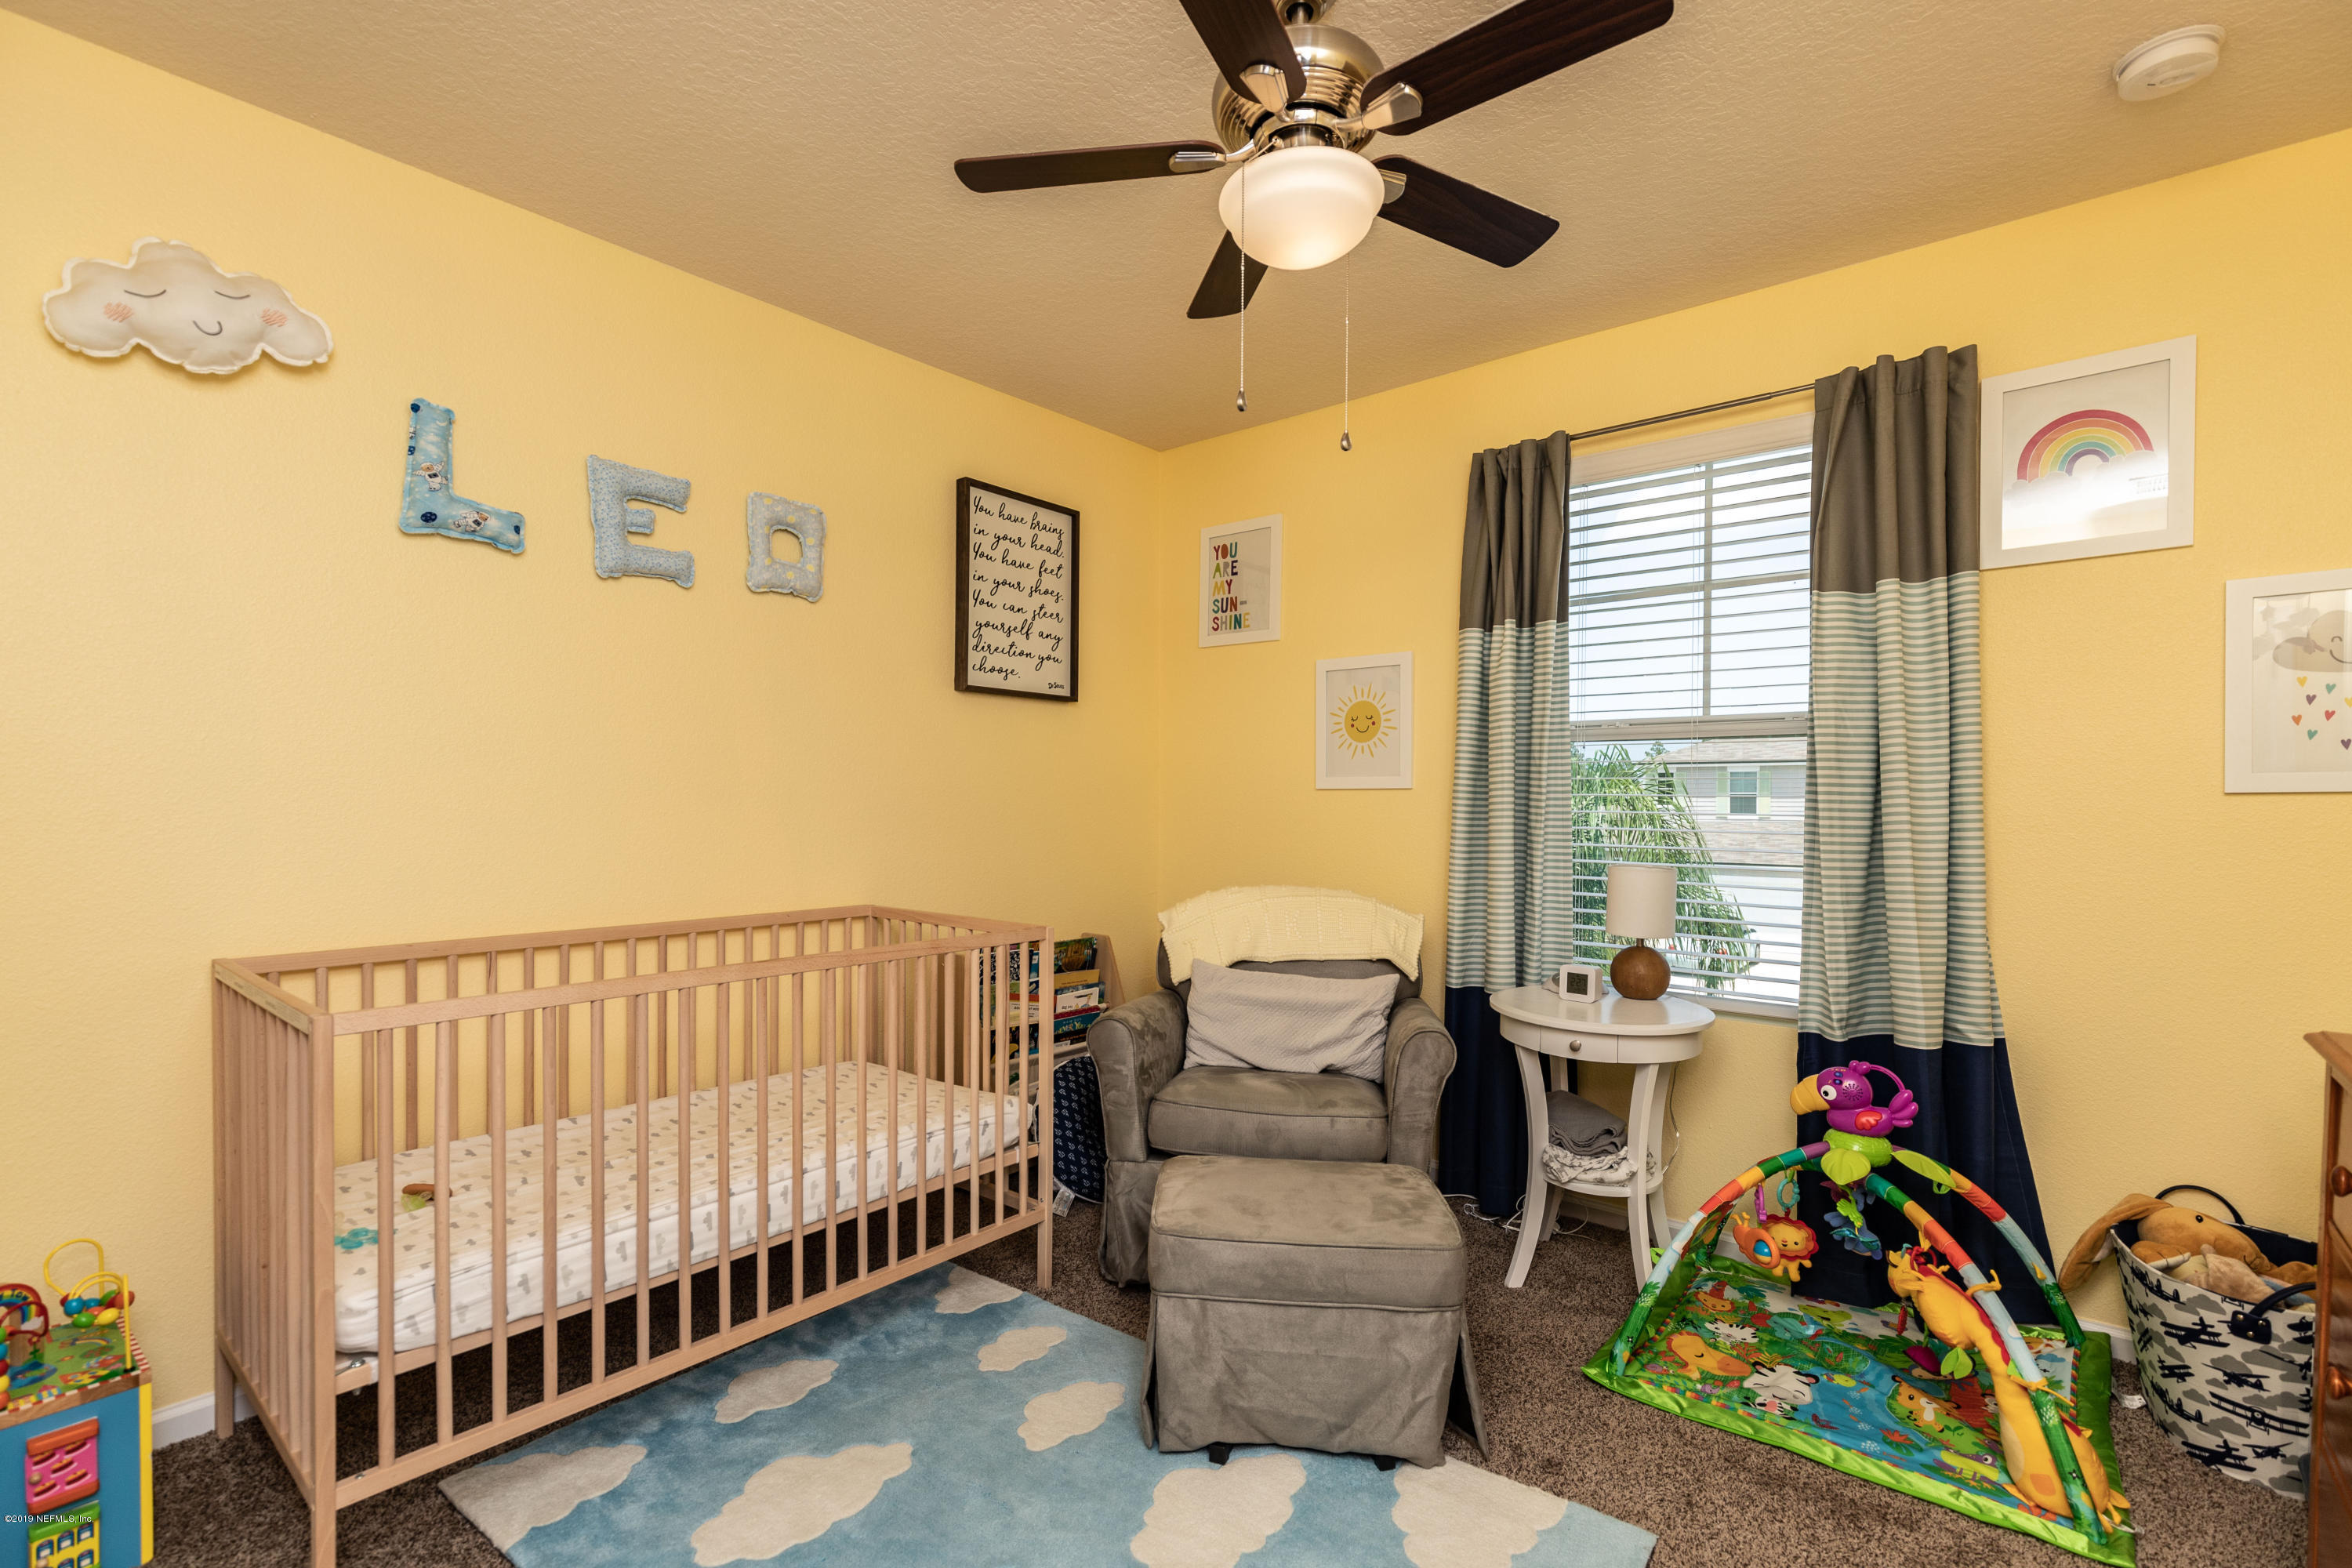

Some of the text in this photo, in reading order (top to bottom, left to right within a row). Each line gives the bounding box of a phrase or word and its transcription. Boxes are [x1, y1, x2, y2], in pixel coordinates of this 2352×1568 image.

[973, 495, 1064, 540] You have brains
[973, 523, 1065, 558] in your head.
[1213, 542, 1238, 561] YOU
[973, 542, 1063, 579] You have feet
[1213, 560, 1238, 579] ARE
[972, 570, 1064, 602] in your shoes.
[1212, 579, 1233, 597] MY
[972, 589, 1063, 623] You can steer
[1211, 612, 1250, 631] SHINE
[972, 619, 1063, 652] yourself any
[972, 633, 1062, 671] direction you
[972, 655, 1021, 681] choose.
